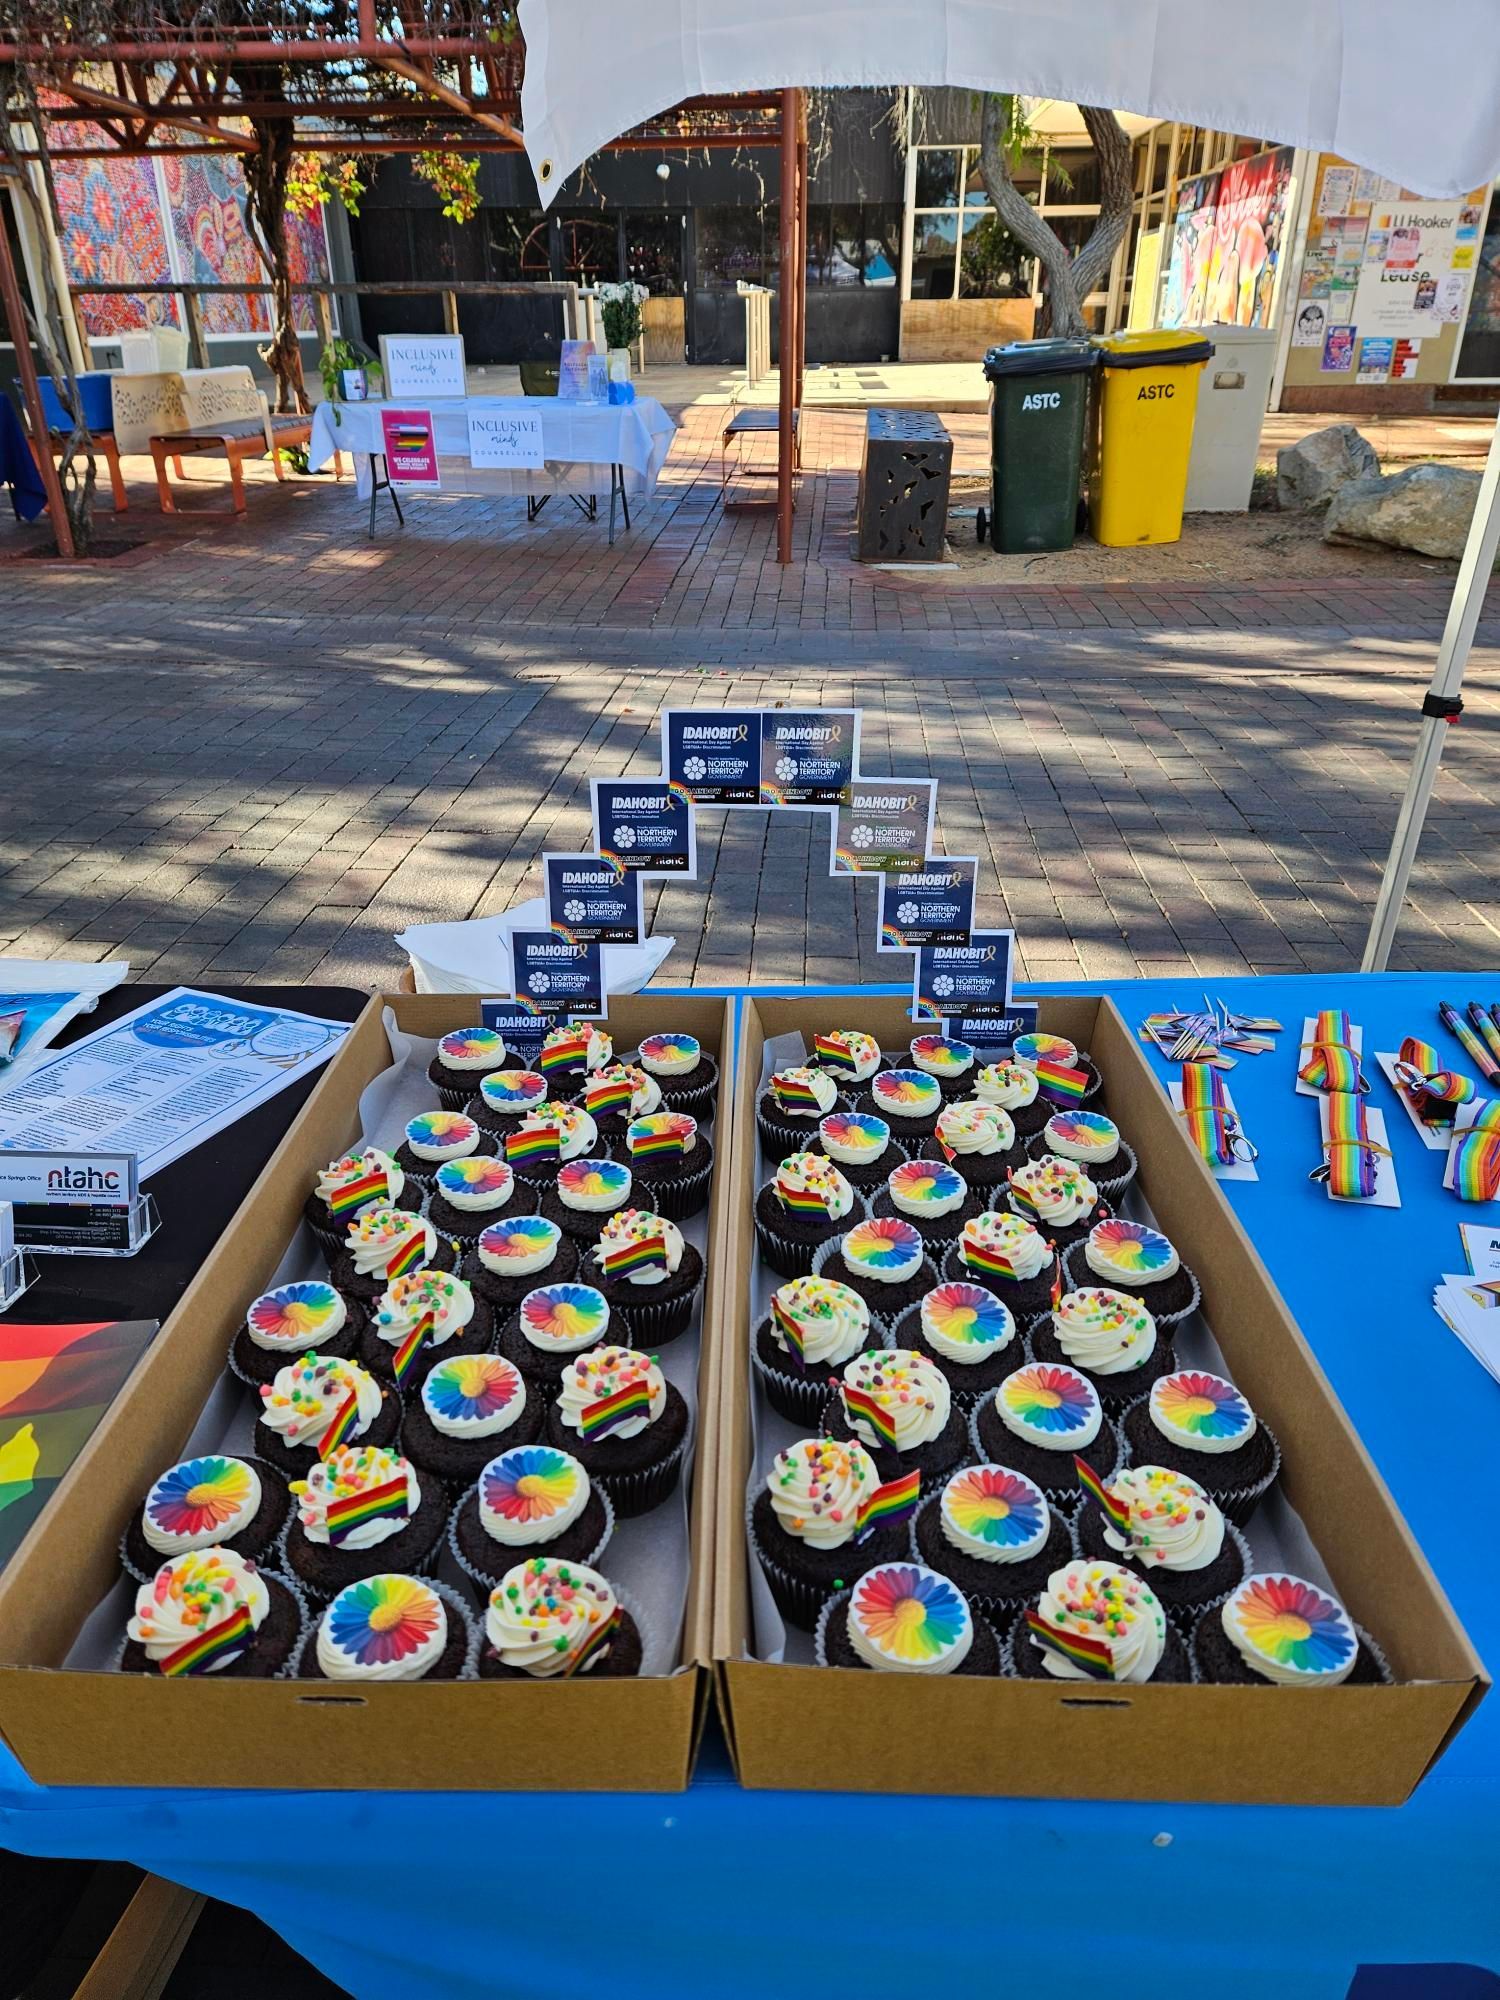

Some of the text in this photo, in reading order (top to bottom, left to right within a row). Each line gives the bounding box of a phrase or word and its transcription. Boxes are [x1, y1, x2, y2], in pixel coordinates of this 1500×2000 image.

[1407, 215, 1454, 228] Hooker
[391, 349, 456, 360] INCLUSIVE
[410, 360, 438, 374] minds
[1137, 384, 1175, 400] ASTC
[1022, 392, 1061, 411] ASTC
[472, 420, 538, 432] INCLUSIVE
[491, 432, 519, 447] minds
[683, 727, 738, 739] IDAHOBIT
[776, 727, 832, 740] IDAHOBIT
[612, 797, 666, 809] IDAHOBIT
[852, 796, 908, 809] IDAHOBIT
[562, 872, 616, 884] IDAHOBIT
[898, 874, 952, 886] IDAHOBIT
[526, 945, 579, 956] IDAHOBIT
[933, 948, 987, 959] IDAHOBIT
[496, 1016, 547, 1027] IDAHOBIT
[962, 1019, 1015, 1030] IDAHOBIT
[48, 1166, 119, 1189] ntahc
